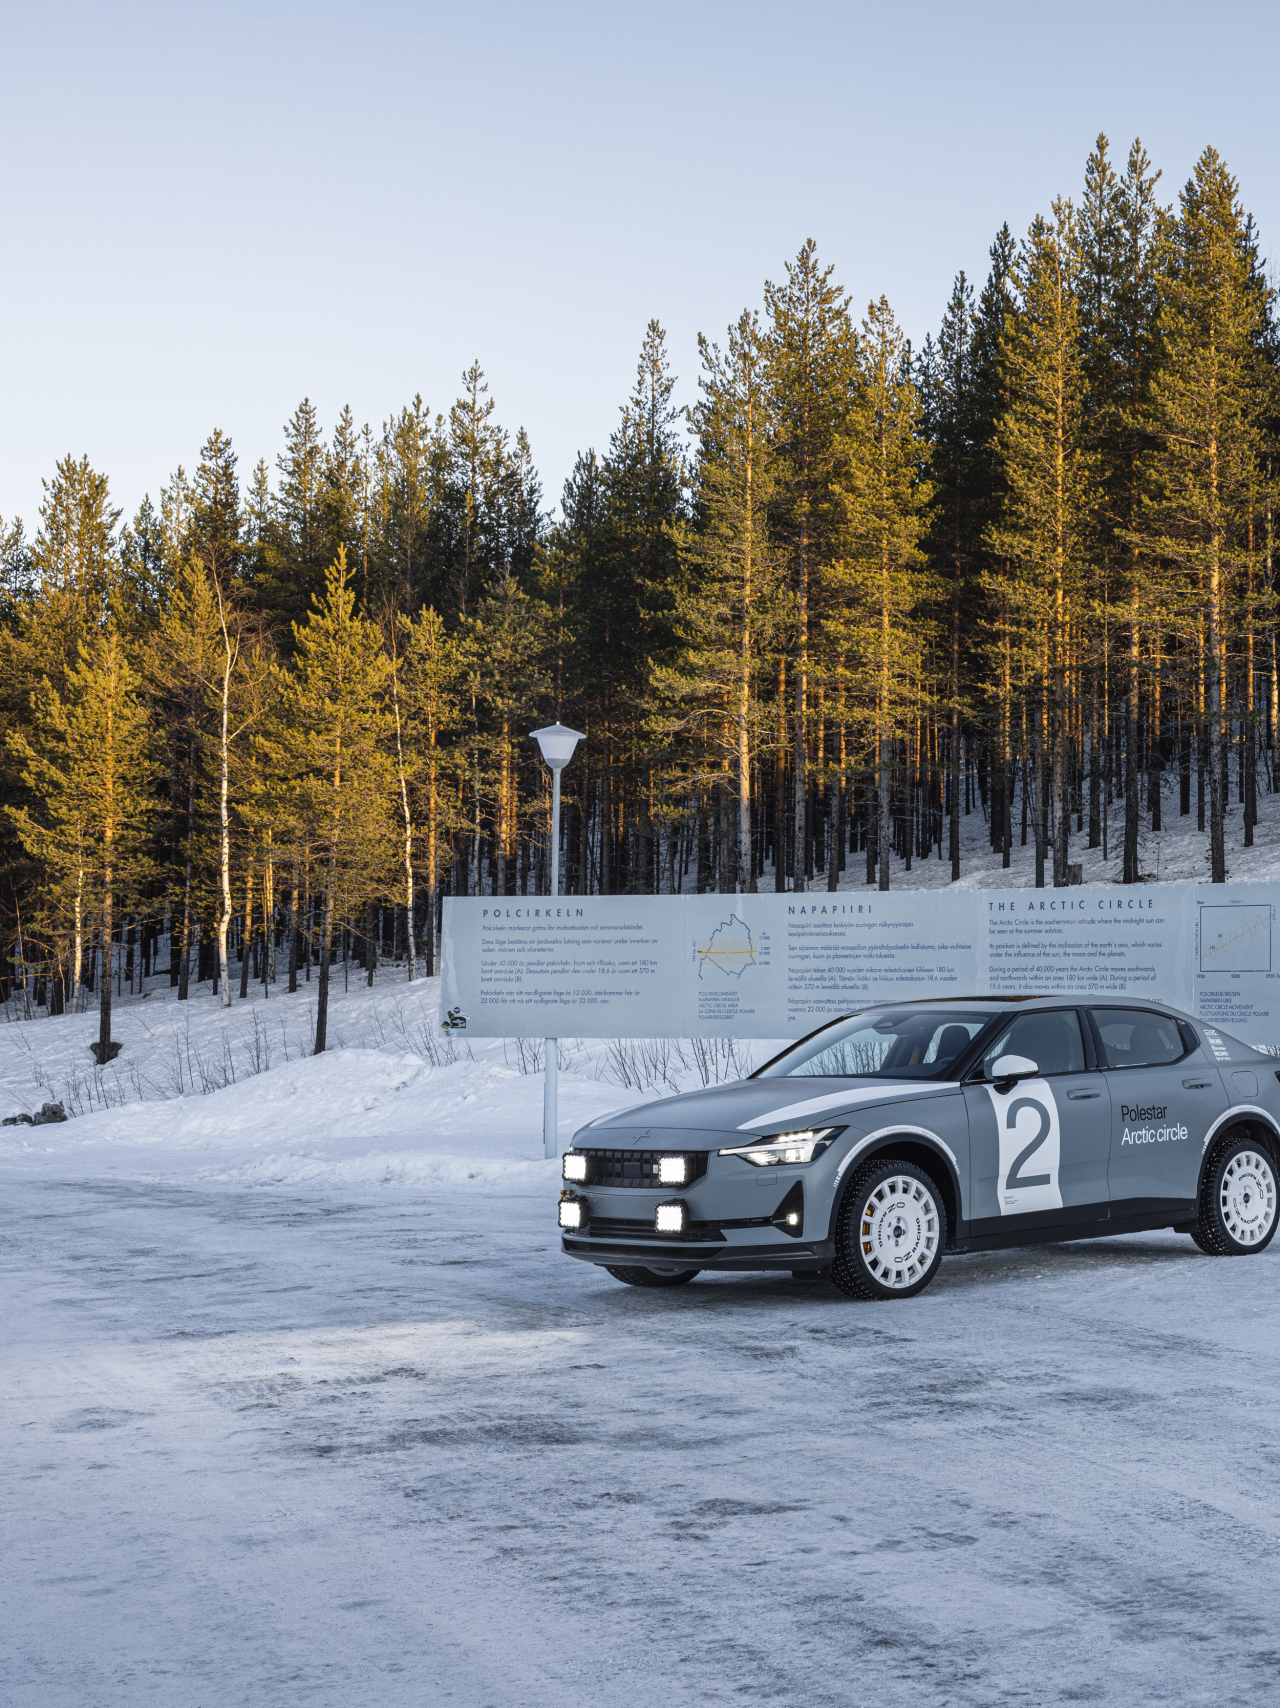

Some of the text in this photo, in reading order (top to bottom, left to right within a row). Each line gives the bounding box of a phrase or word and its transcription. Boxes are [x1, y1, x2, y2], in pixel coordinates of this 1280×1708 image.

[788, 905, 872, 914] NAPAPIIRI
[989, 899, 1153, 911] THE ARCTIC CIRCLE
[483, 908, 583, 918] POLCIRKELN
[1122, 917, 1145, 925] midnight
[995, 942, 1015, 951] position
[1118, 941, 1129, 949] axis,
[1107, 950, 1126, 959] planets.
[989, 966, 1006, 974] During
[1012, 966, 1028, 974] period
[1121, 1104, 1167, 1122] Polestar
[1121, 1123, 1188, 1146] Arctic circle
[1006, 1097, 1051, 1190] 2
[912, 1217, 921, 1253] RACING
